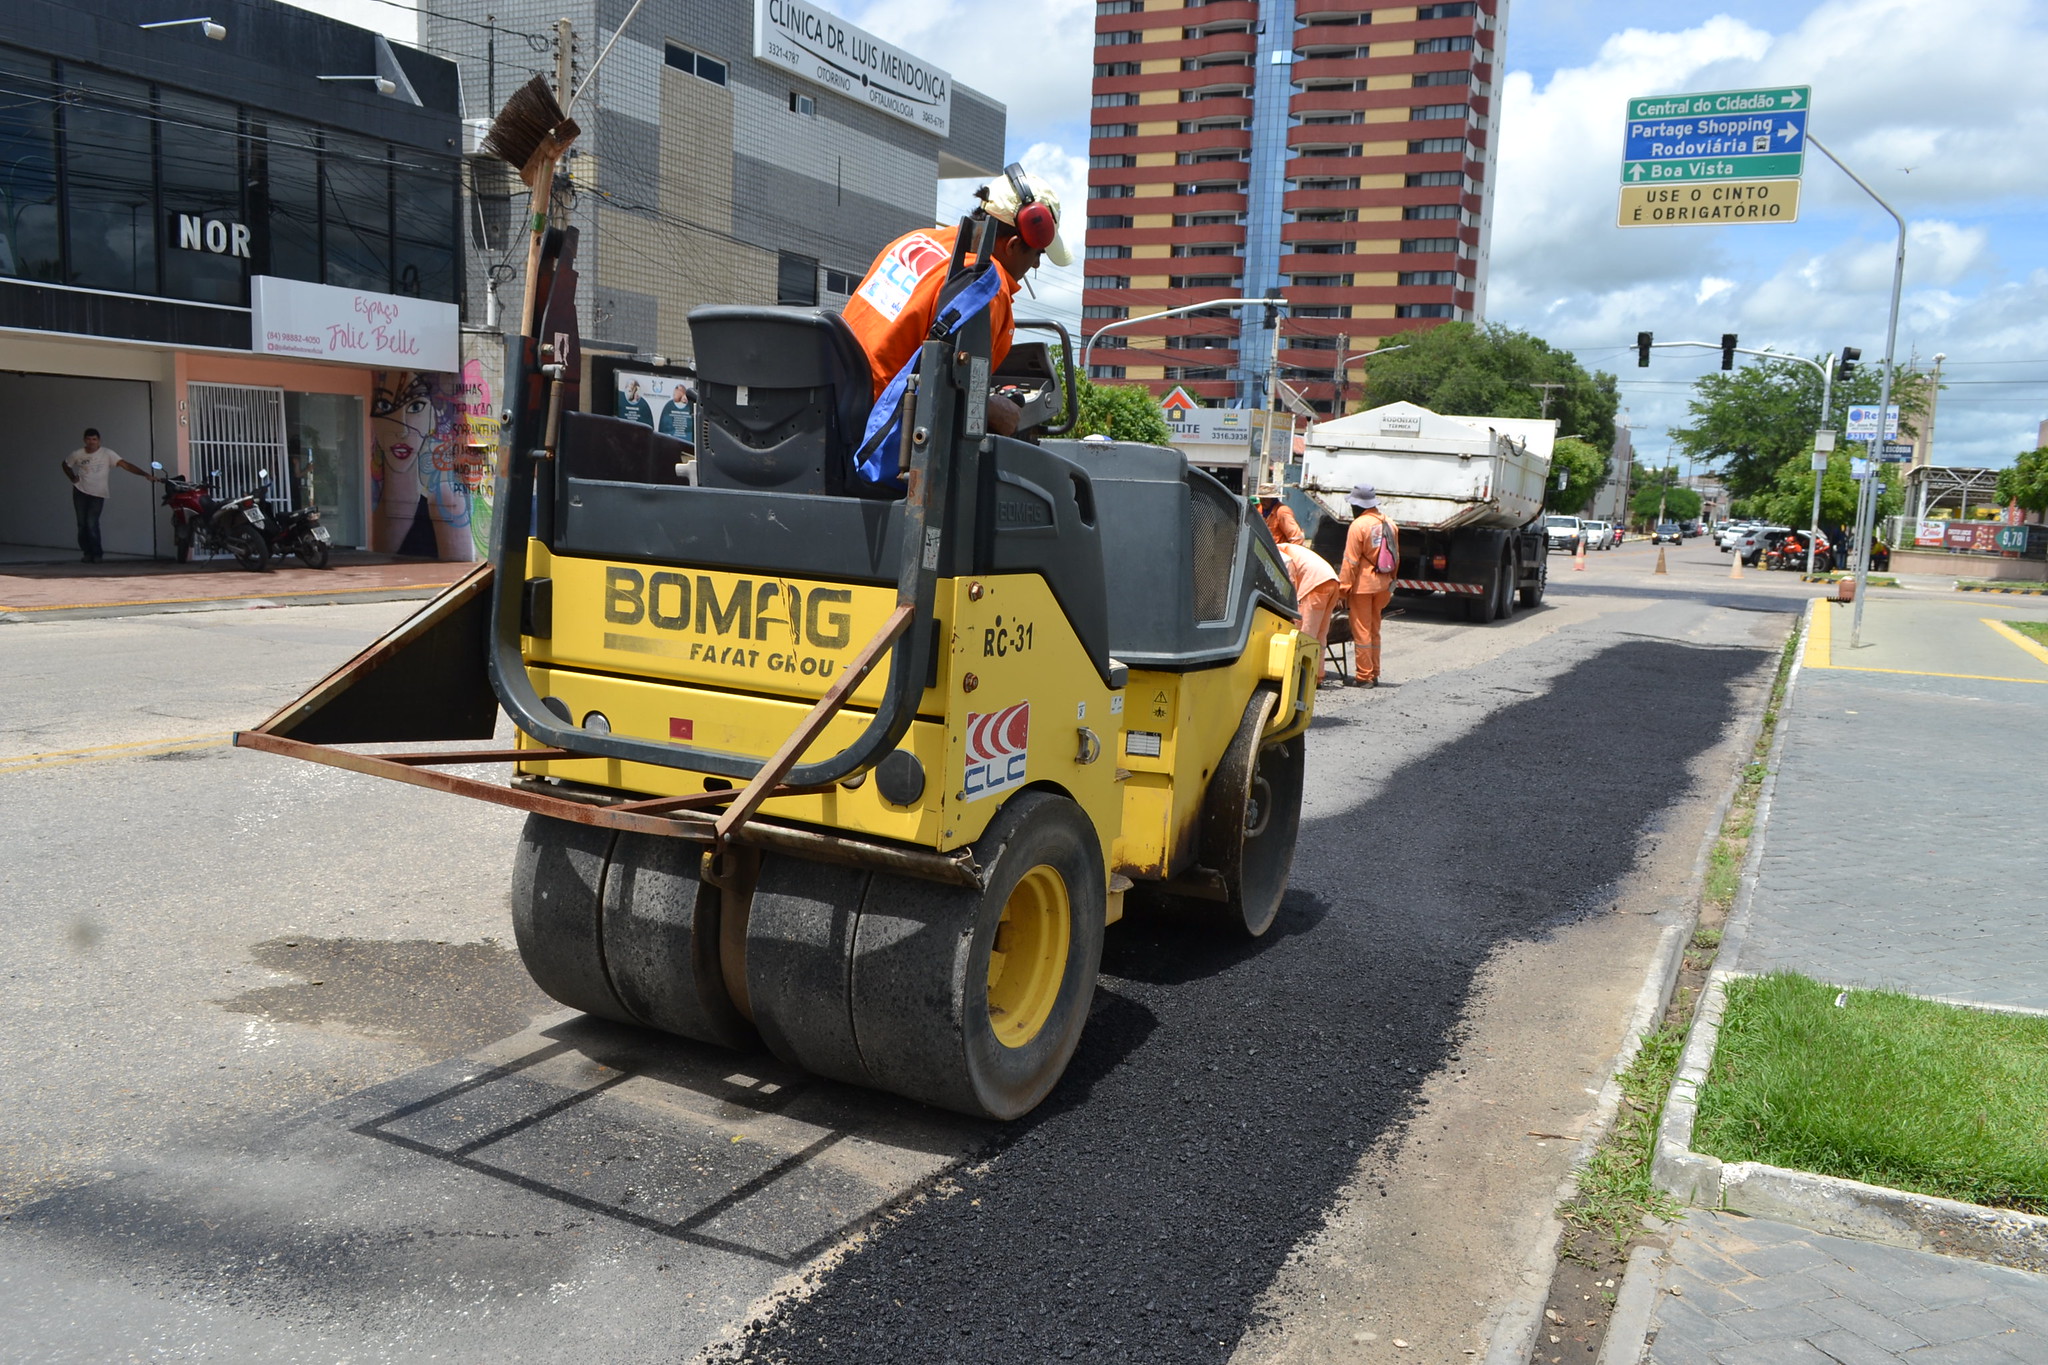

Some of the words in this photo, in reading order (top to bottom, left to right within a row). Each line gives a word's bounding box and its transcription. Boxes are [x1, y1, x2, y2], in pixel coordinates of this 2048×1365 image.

[768, 41, 800, 65] 3321-4787
[827, 24, 848, 57] DR.
[852, 36, 878, 70] LUIS
[881, 51, 946, 105] MENDONÇA
[817, 66, 850, 91] OTORRINO
[869, 89, 914, 119] OFTALMOLOGIA
[1636, 100, 1690, 116] Central
[1693, 98, 1711, 112] do
[1716, 94, 1774, 110] Cidadão
[1632, 123, 1693, 139] Partage
[1697, 118, 1773, 136] Shopping
[1652, 138, 1747, 157] Rodoviária
[1651, 164, 1682, 178] Boa
[1689, 161, 1734, 175] Vista
[1647, 190, 1680, 203] USE
[1690, 189, 1701, 201] O
[1713, 186, 1769, 200] CINTO
[1633, 206, 1643, 221] É
[1653, 202, 1781, 220] OBRIGATÓRIO
[179, 213, 251, 258] NOR
[354, 296, 399, 325] Espaço
[326, 322, 368, 351] Jolie
[371, 325, 420, 355] Belle
[1864, 411, 1897, 420] Rena
[2003, 531, 2023, 547] 9,78
[604, 566, 853, 651] BOMAG
[983, 622, 1033, 657] RC-31
[690, 643, 760, 669] FAYAT
[964, 753, 1026, 795] CLC
